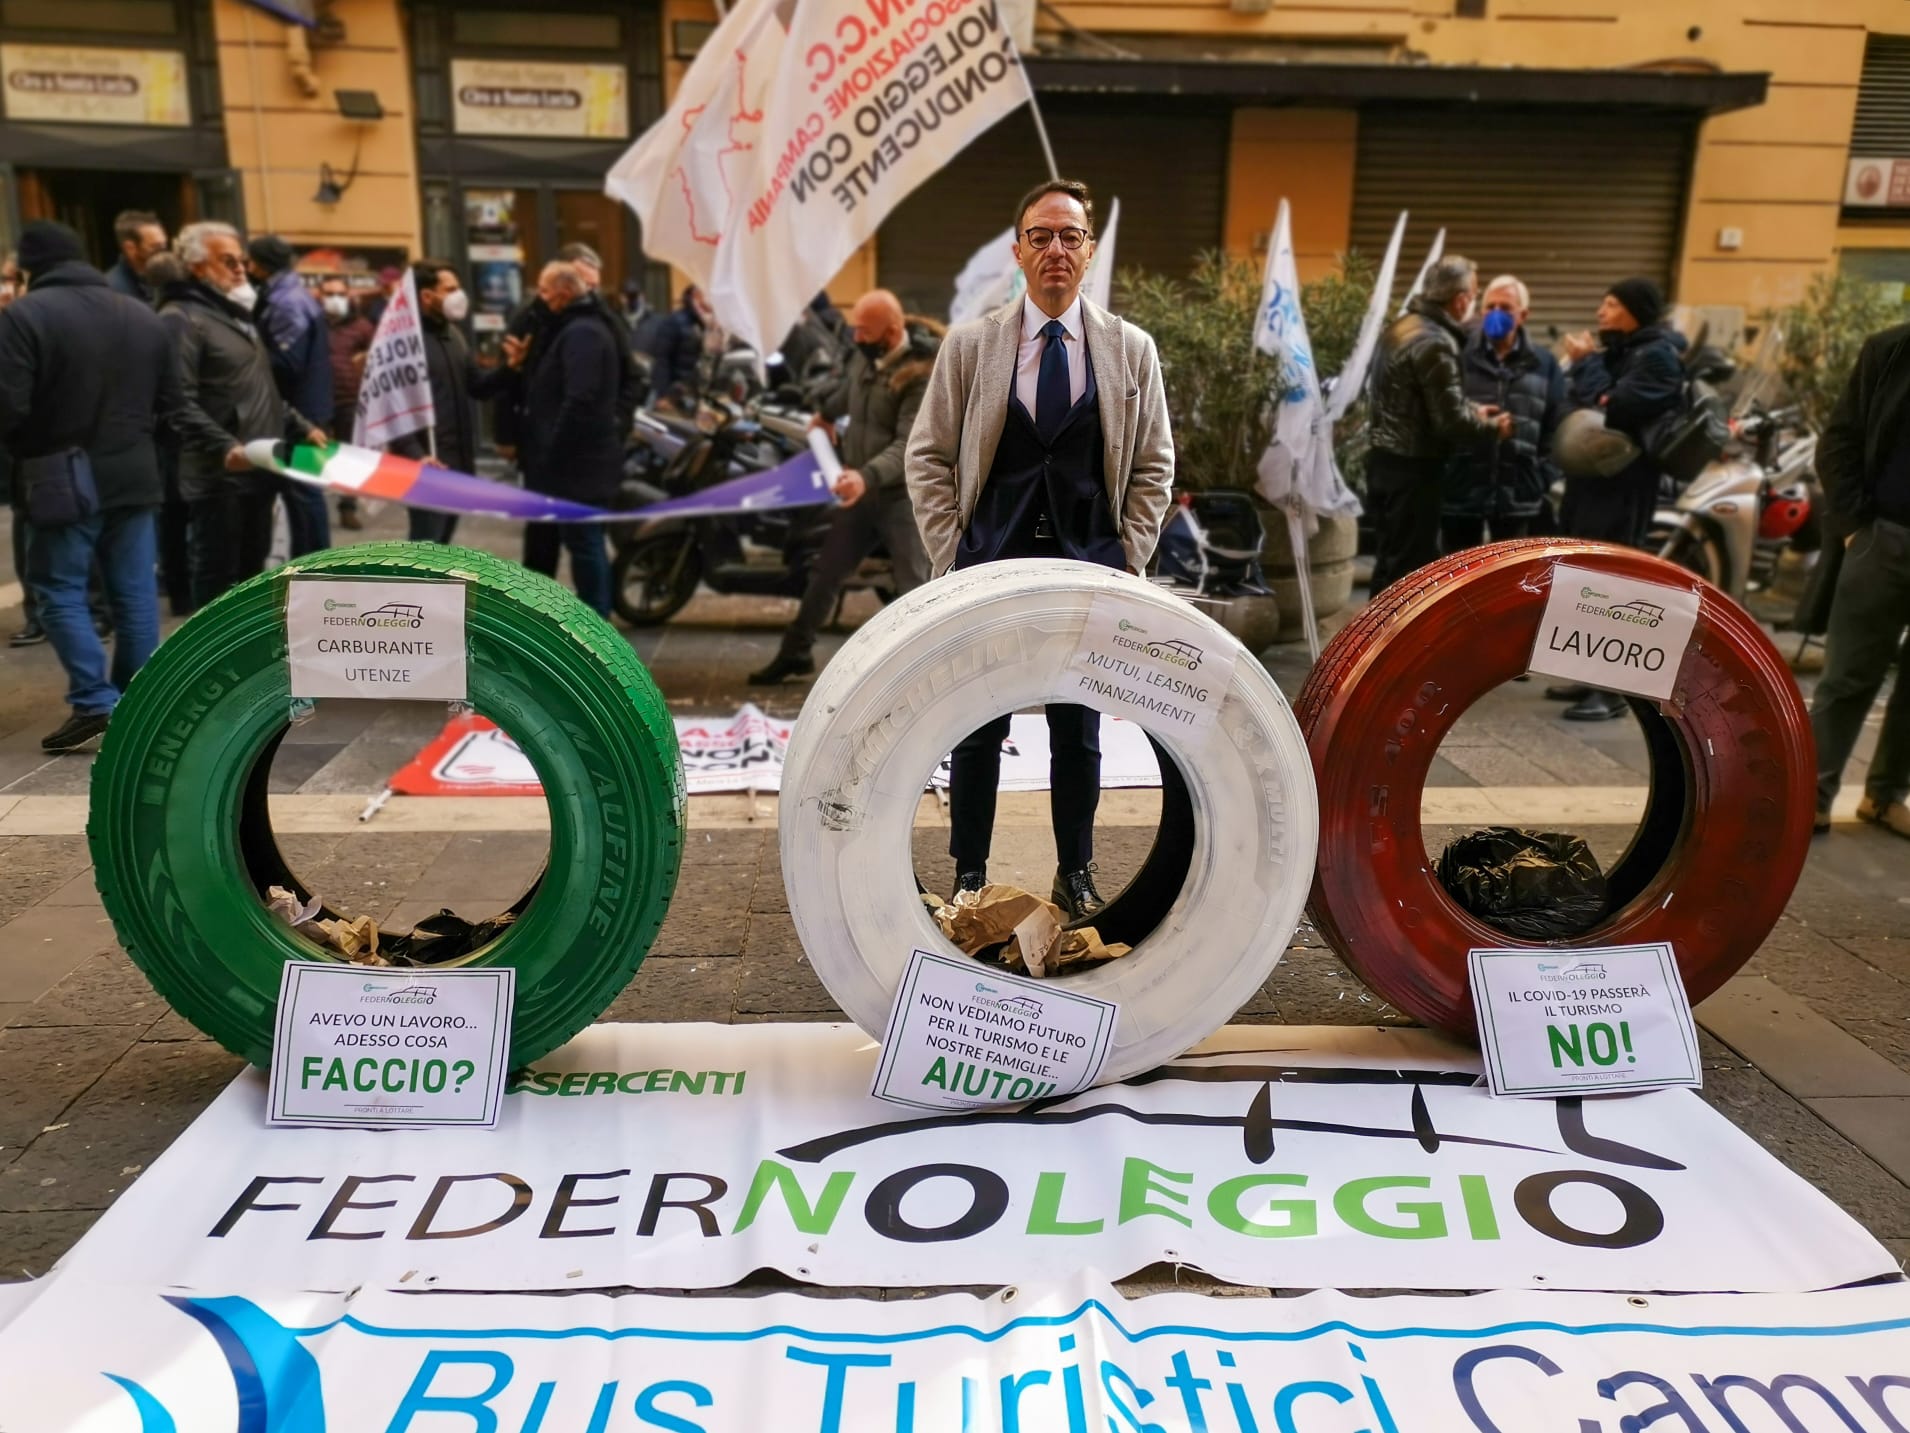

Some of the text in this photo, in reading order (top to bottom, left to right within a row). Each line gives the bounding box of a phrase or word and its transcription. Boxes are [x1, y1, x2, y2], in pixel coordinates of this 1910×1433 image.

[323, 616, 422, 629] FEDERNOLEGGIO
[1576, 602, 1660, 628] FEDERNOLEGGIO
[317, 639, 434, 656] CARBURANTE
[1113, 635, 1198, 671] FEDERNOLEGGIO
[1549, 626, 1665, 672] LAVORO
[345, 668, 412, 683] UTENZE
[1087, 651, 1209, 703] MUTUI, LEASING
[1079, 676, 1197, 726] FINANZIAMENTI
[149, 666, 240, 778] ENERGY
[360, 995, 434, 1005] FEDERNOLEGGIO
[972, 995, 1040, 1020] FEDERNOLEGGIO
[1508, 984, 1650, 1003] IL COVID-19 PASSERÀ
[1544, 1003, 1623, 1017] IL TURISMO
[309, 1012, 478, 1029] AVEVO UN LAVORO...
[920, 993, 1086, 1048] NON VEDIAMO FUTURO
[928, 1015, 1070, 1063] PER IL TURISMO E LE
[334, 1033, 448, 1048] ADESSO COSA
[926, 1034, 1059, 1080] NOSTRE FAMIGLIE...
[1547, 1021, 1636, 1068] NO!
[301, 1056, 475, 1094] FACCIO?
[208, 1156, 1665, 1251] FEDERNOLEGGIO
[384, 1350, 714, 1433] Bus
[786, 1333, 1401, 1433] Turistici
